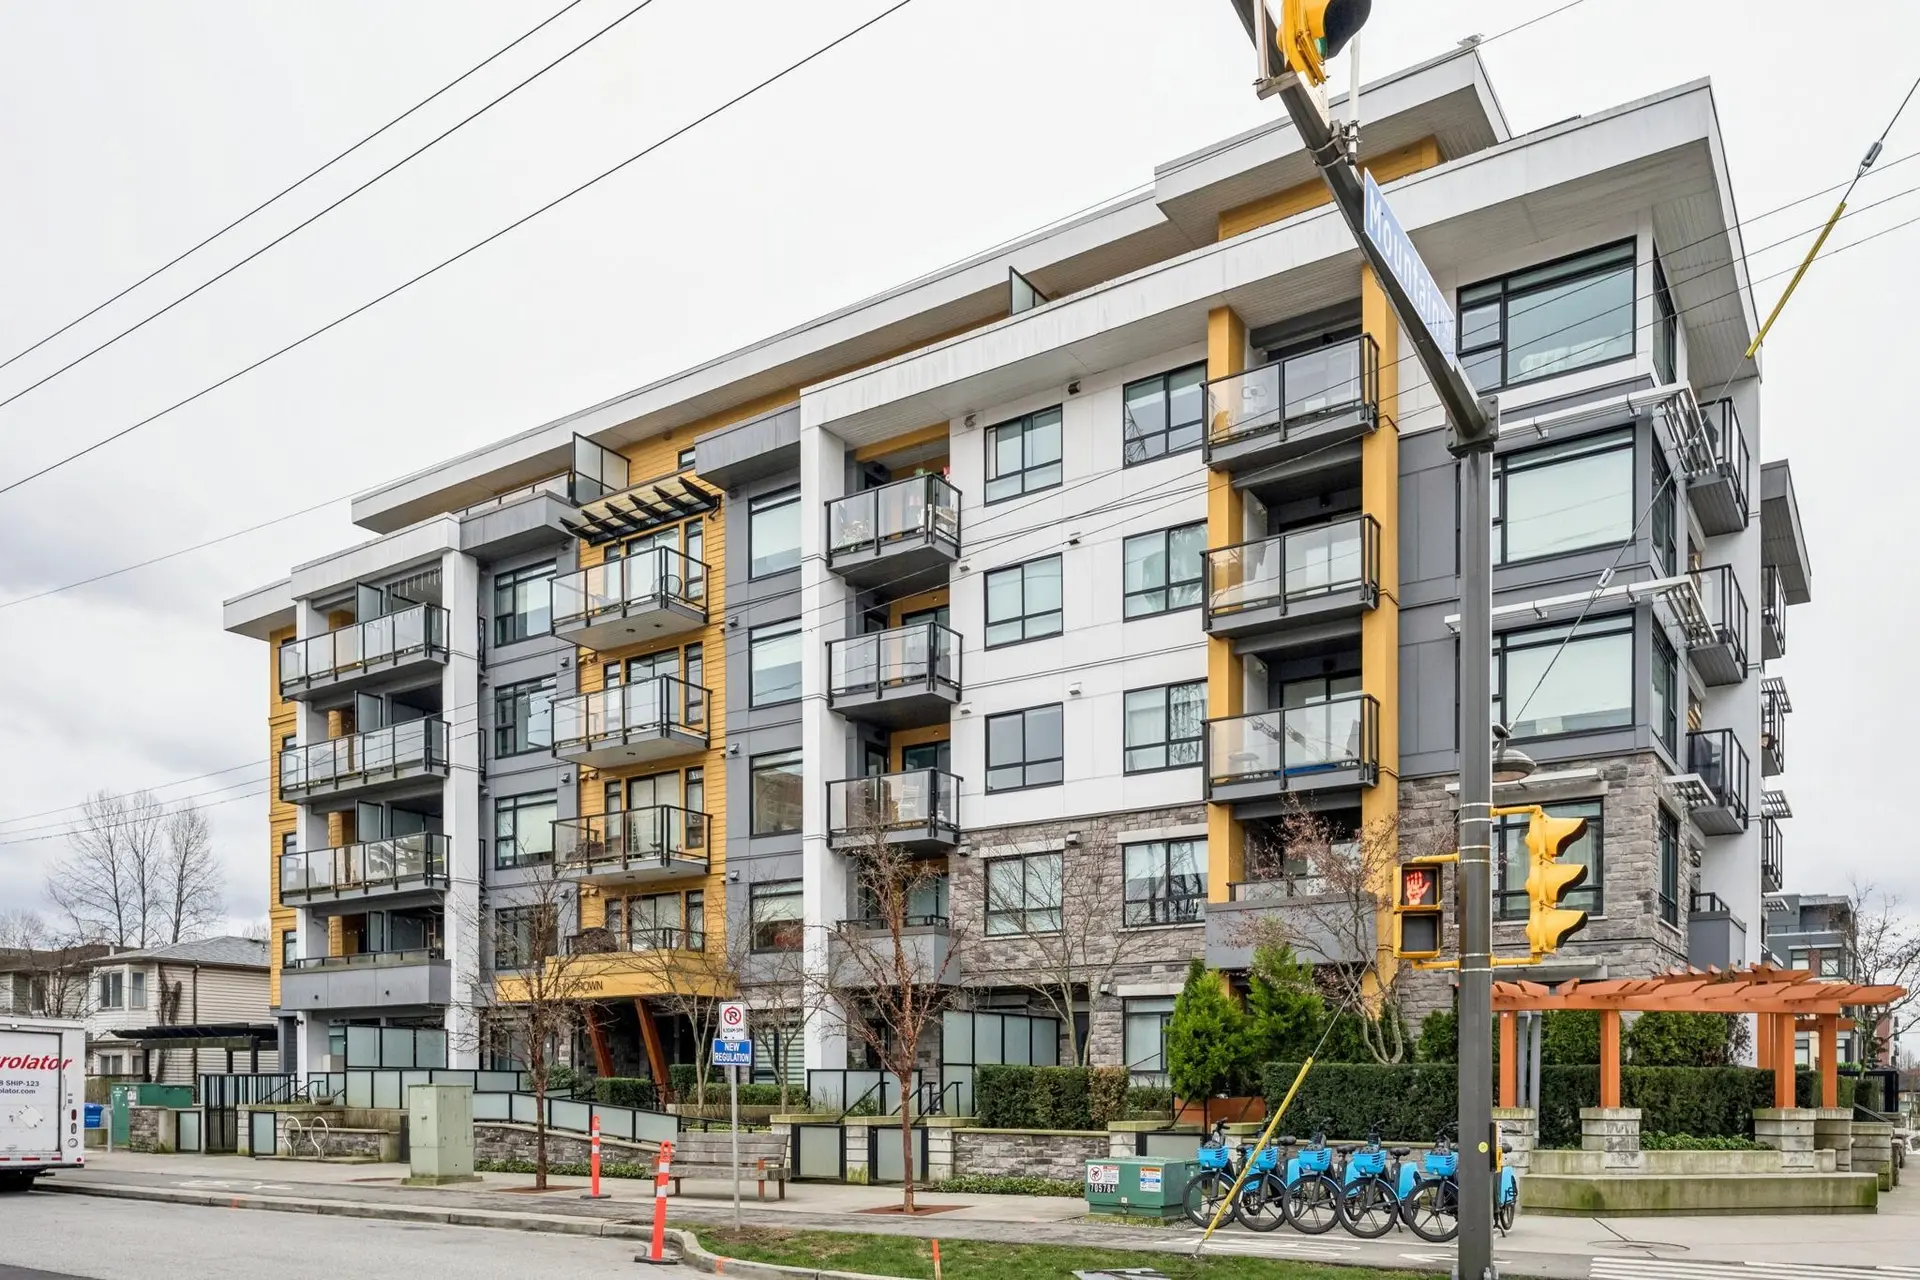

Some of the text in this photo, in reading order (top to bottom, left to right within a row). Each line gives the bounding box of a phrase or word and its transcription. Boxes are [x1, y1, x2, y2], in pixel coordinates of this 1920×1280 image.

[1369, 187, 1440, 336] Mountain
[724, 1042, 740, 1052] NEW
[0, 1054, 73, 1070] rolator
[714, 1052, 749, 1062] REGULATION
[1090, 1183, 1116, 1193] 705784
